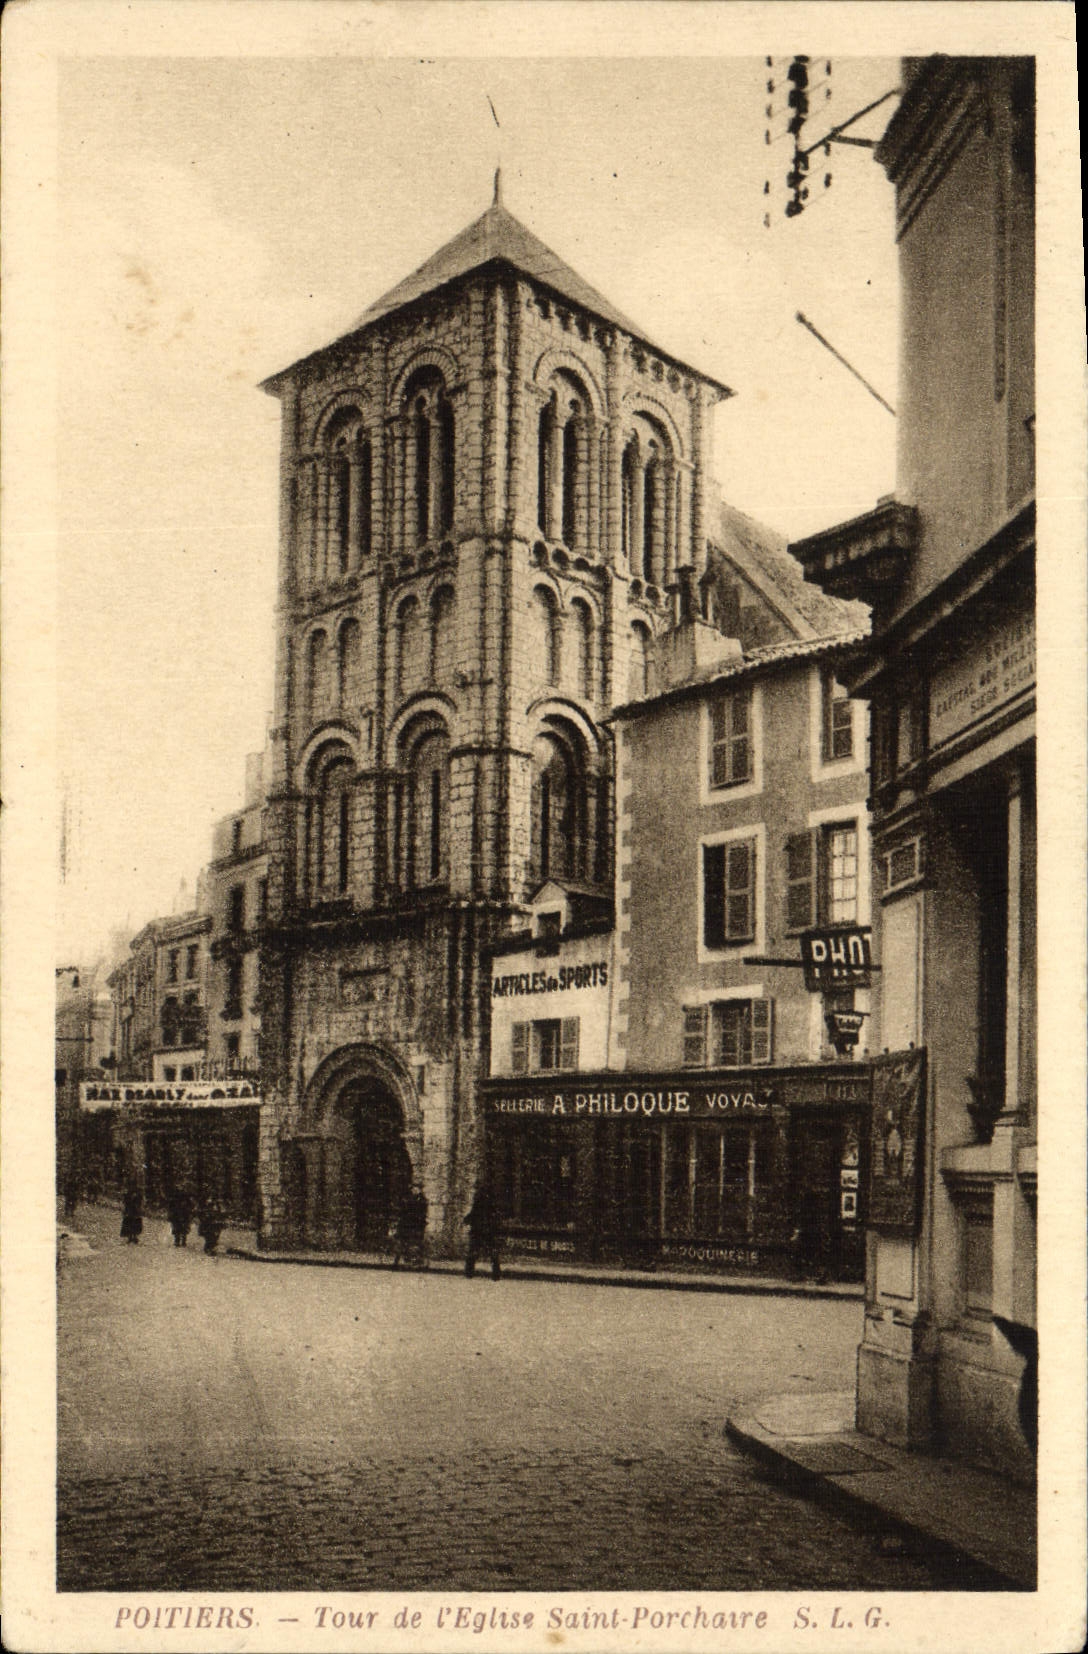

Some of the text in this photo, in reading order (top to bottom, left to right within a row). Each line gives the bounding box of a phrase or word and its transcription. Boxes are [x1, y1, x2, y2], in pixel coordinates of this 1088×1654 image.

[492, 971, 546, 998] ARTICLES
[559, 962, 609, 991] SPORTS
[552, 1094, 566, 1114] A
[575, 1091, 690, 1116] PHILOQUE
[706, 1092, 767, 1110] VOYA
